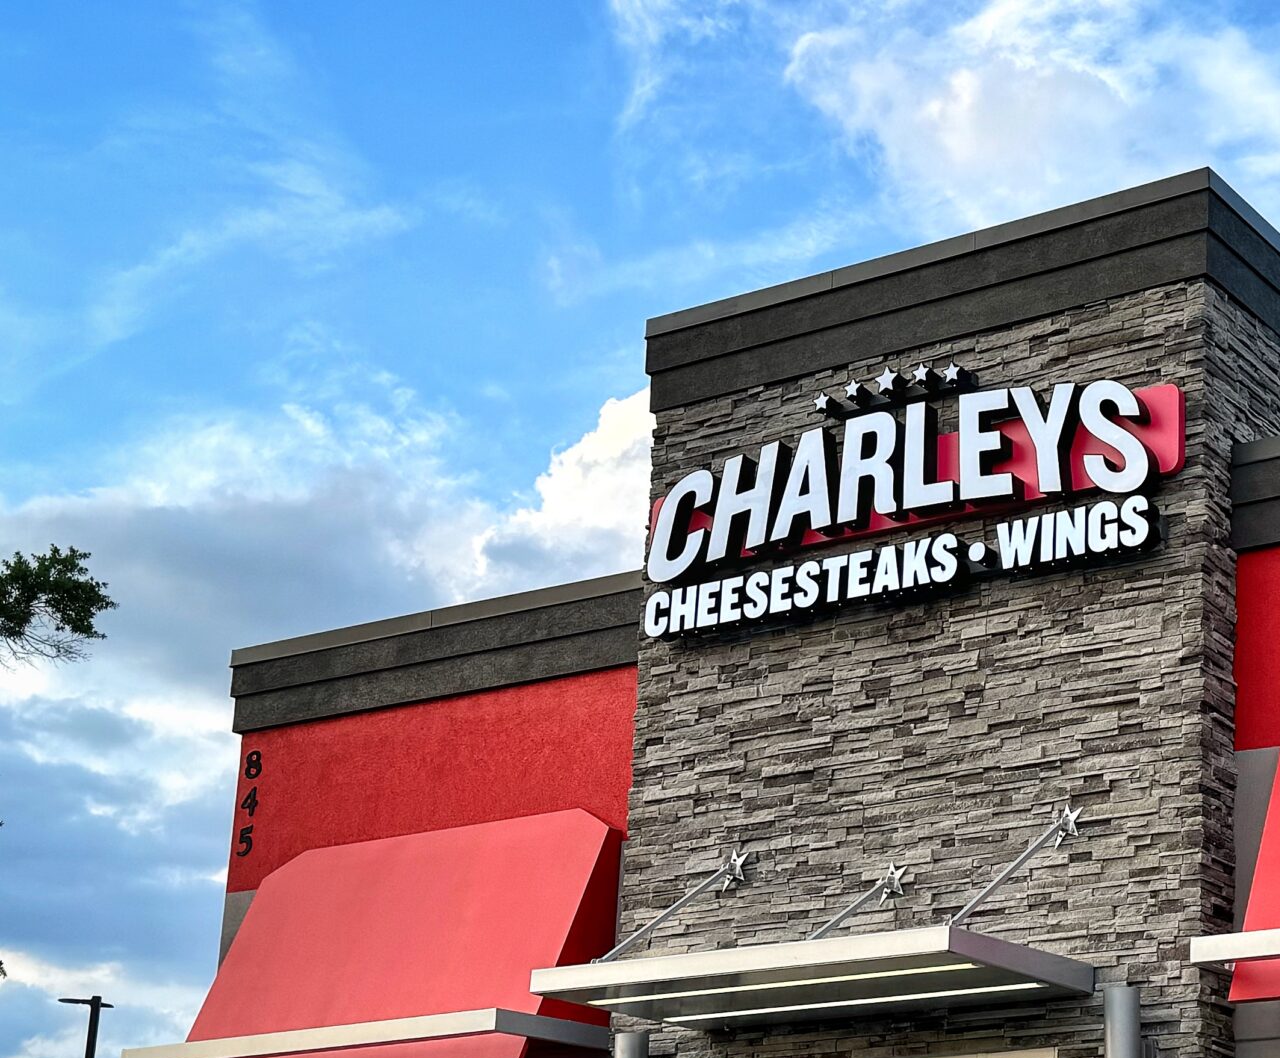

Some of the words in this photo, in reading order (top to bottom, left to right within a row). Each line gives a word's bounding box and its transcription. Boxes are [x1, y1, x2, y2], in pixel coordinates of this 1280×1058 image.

[646, 379, 1150, 584] CHARLEYS
[644, 533, 958, 638] CHEESESTEAKS
[997, 495, 1150, 569] WINGS
[236, 750, 262, 857] 845
